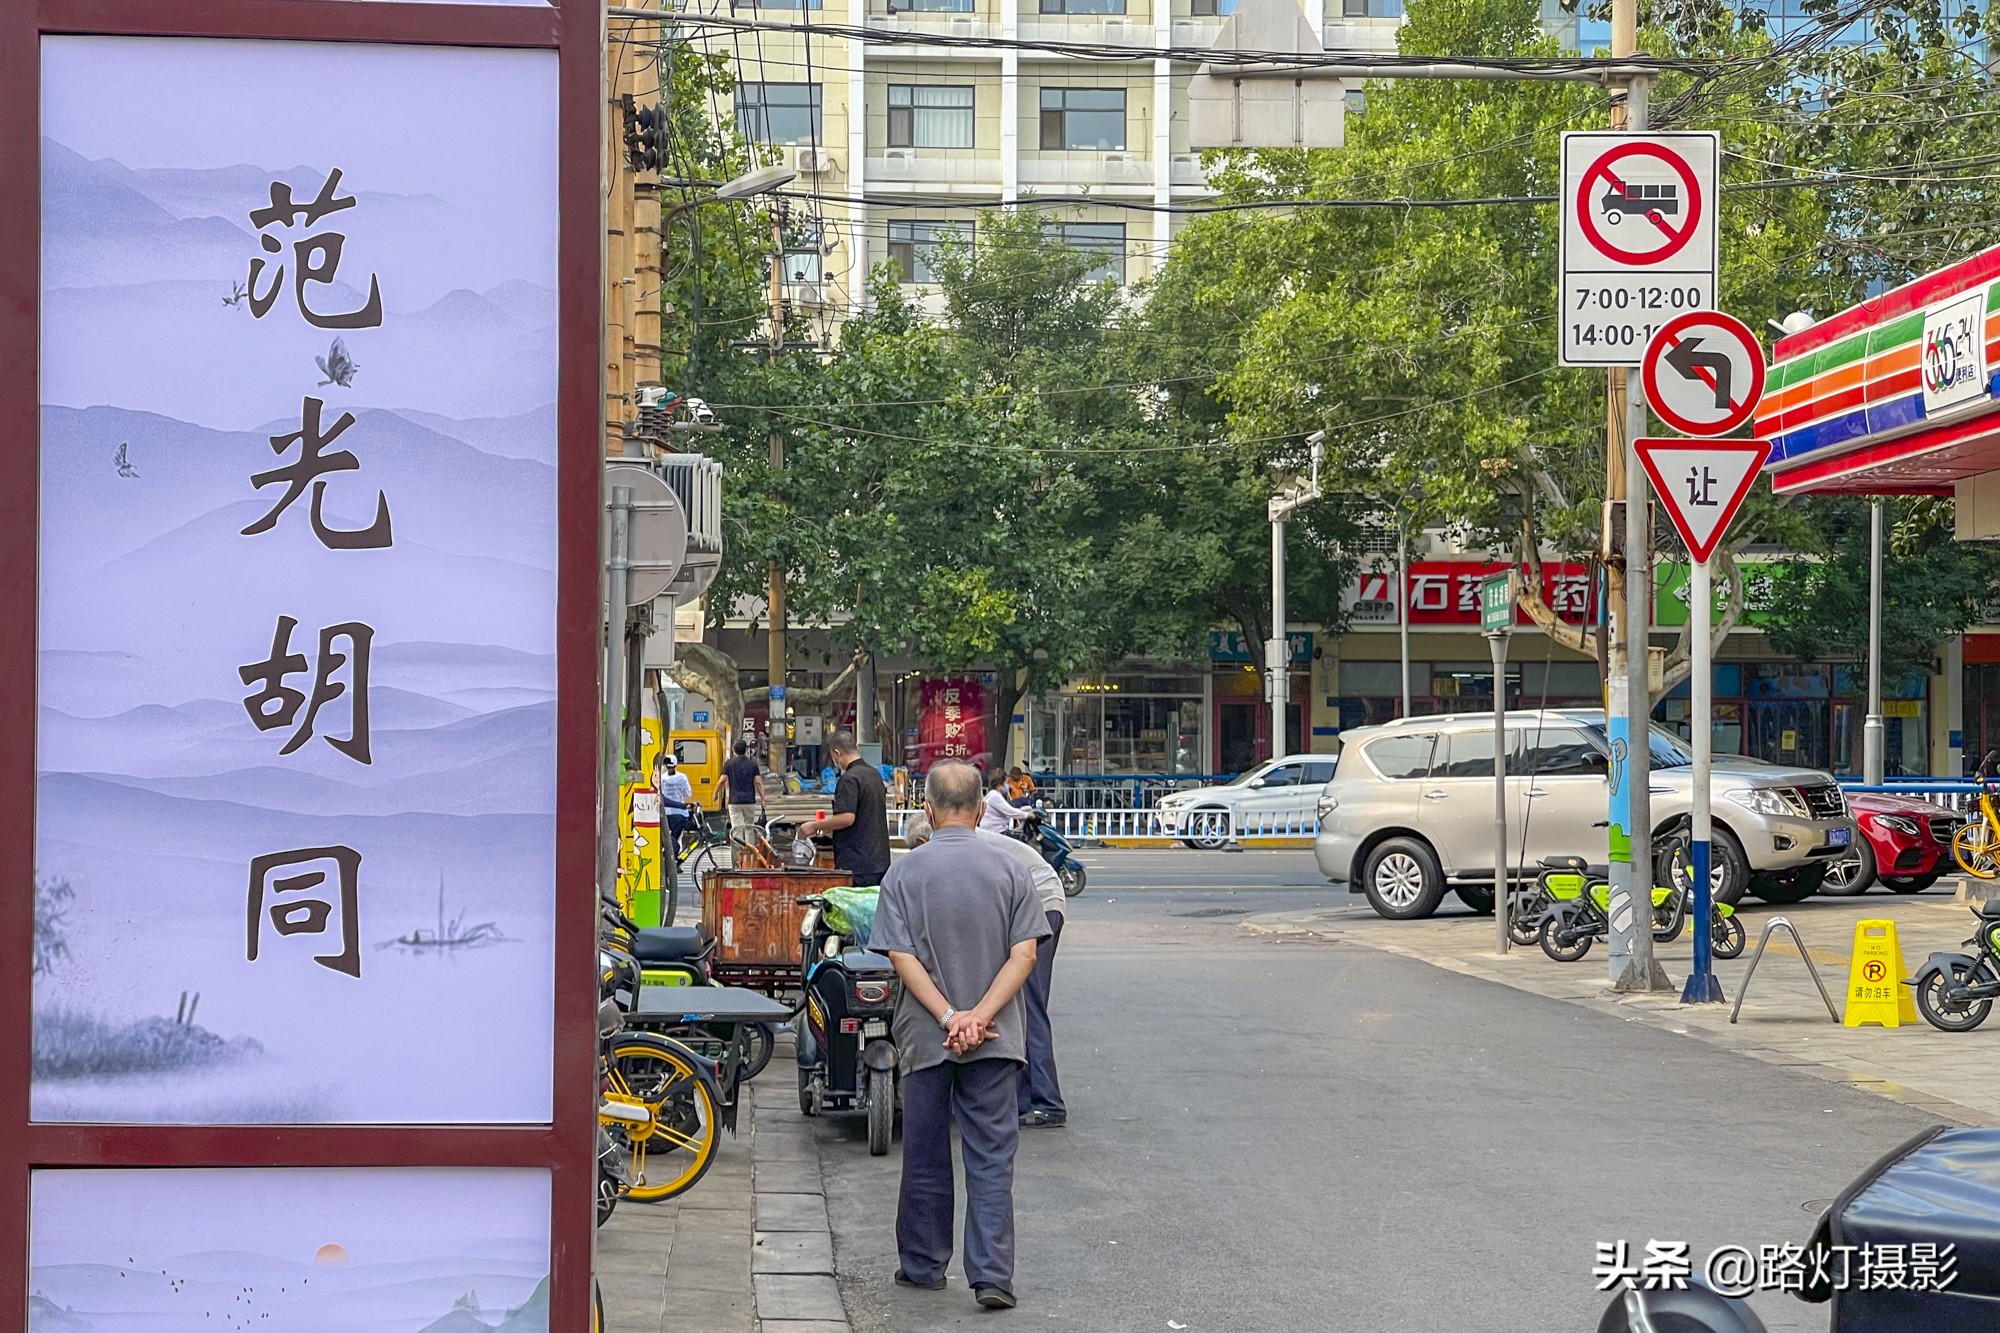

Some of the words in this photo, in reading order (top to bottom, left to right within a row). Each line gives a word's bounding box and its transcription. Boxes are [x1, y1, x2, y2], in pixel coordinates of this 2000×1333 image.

[1576, 287, 1701, 310] 7:00-12:00
[1573, 324, 1661, 346] 14:00-1
[1955, 363, 1975, 382] 便利店
[1685, 466, 1718, 506] 让
[238, 167, 393, 978] 范光胡同
[944, 688, 963, 738] 反季购
[1855, 986, 1891, 999] 请勿泊车
